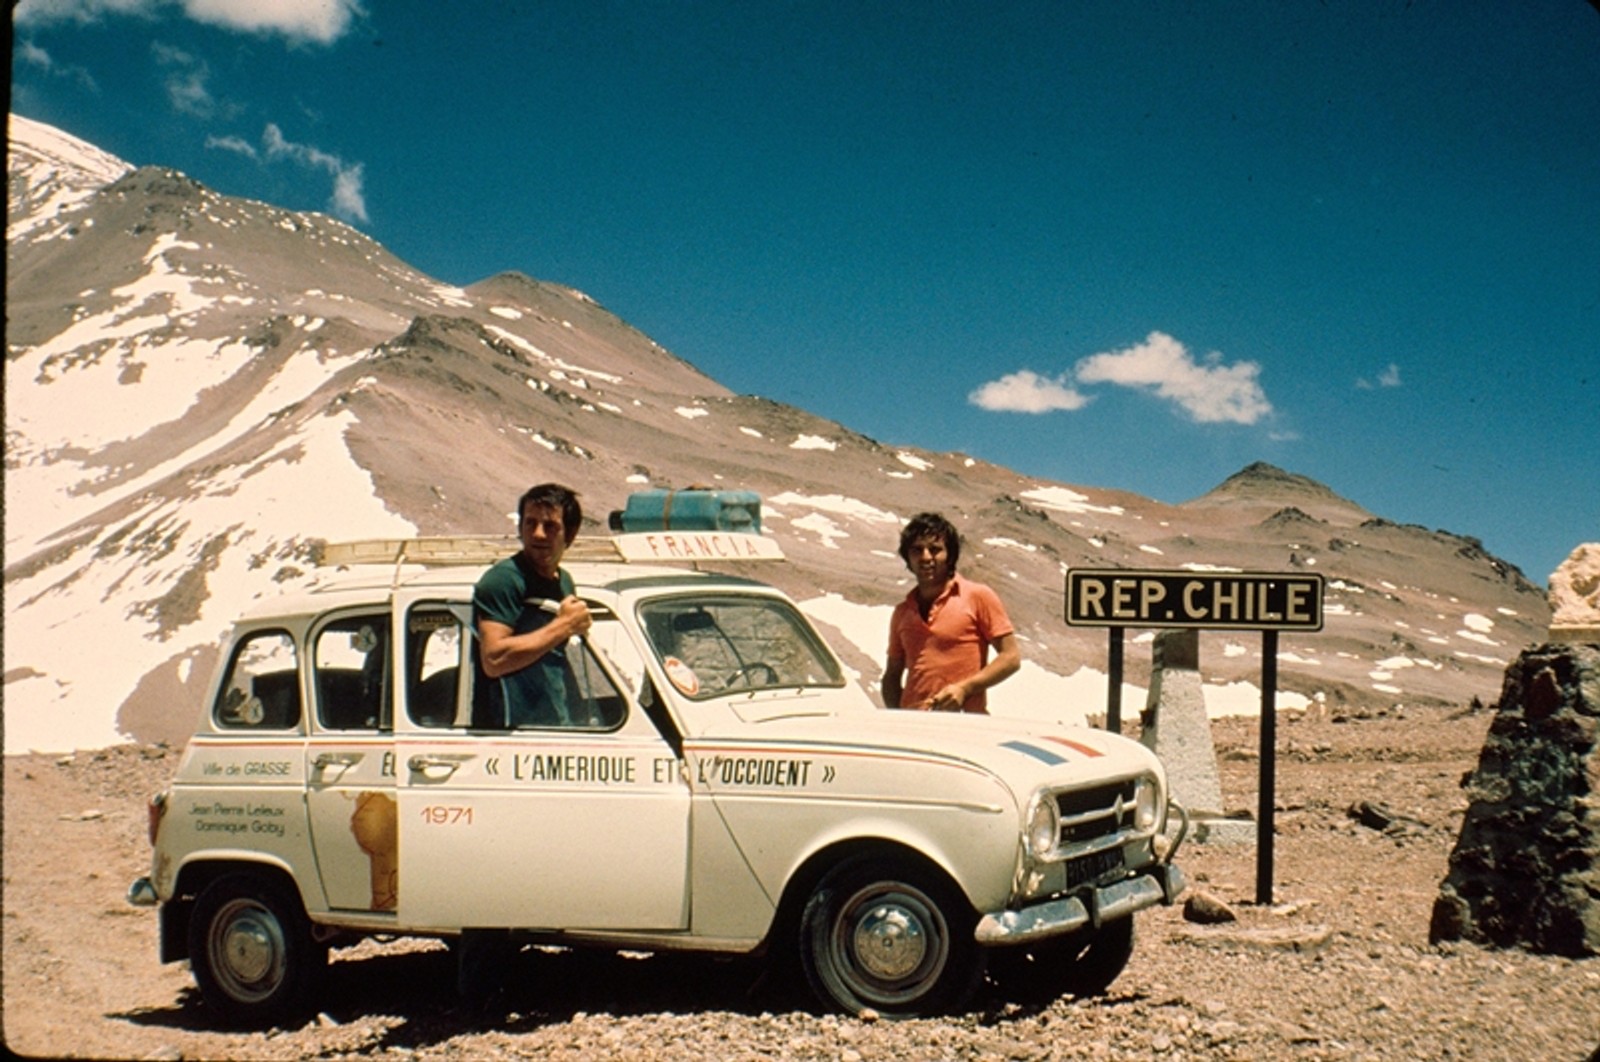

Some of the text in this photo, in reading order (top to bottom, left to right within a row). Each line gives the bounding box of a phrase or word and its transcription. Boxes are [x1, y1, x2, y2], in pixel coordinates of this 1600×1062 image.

[646, 535, 761, 557] FRANCIA
[1080, 578, 1311, 622] REP. CHILE
[203, 761, 292, 776] Ville de GRASSE
[513, 754, 636, 783] L'AMERIQUE
[653, 757, 676, 783] ET
[699, 757, 812, 787] L'OCCIDENT
[188, 802, 212, 816] Jean
[214, 802, 244, 816] Pierre
[420, 806, 474, 825] 1971
[196, 820, 285, 838] Dominique Goby
